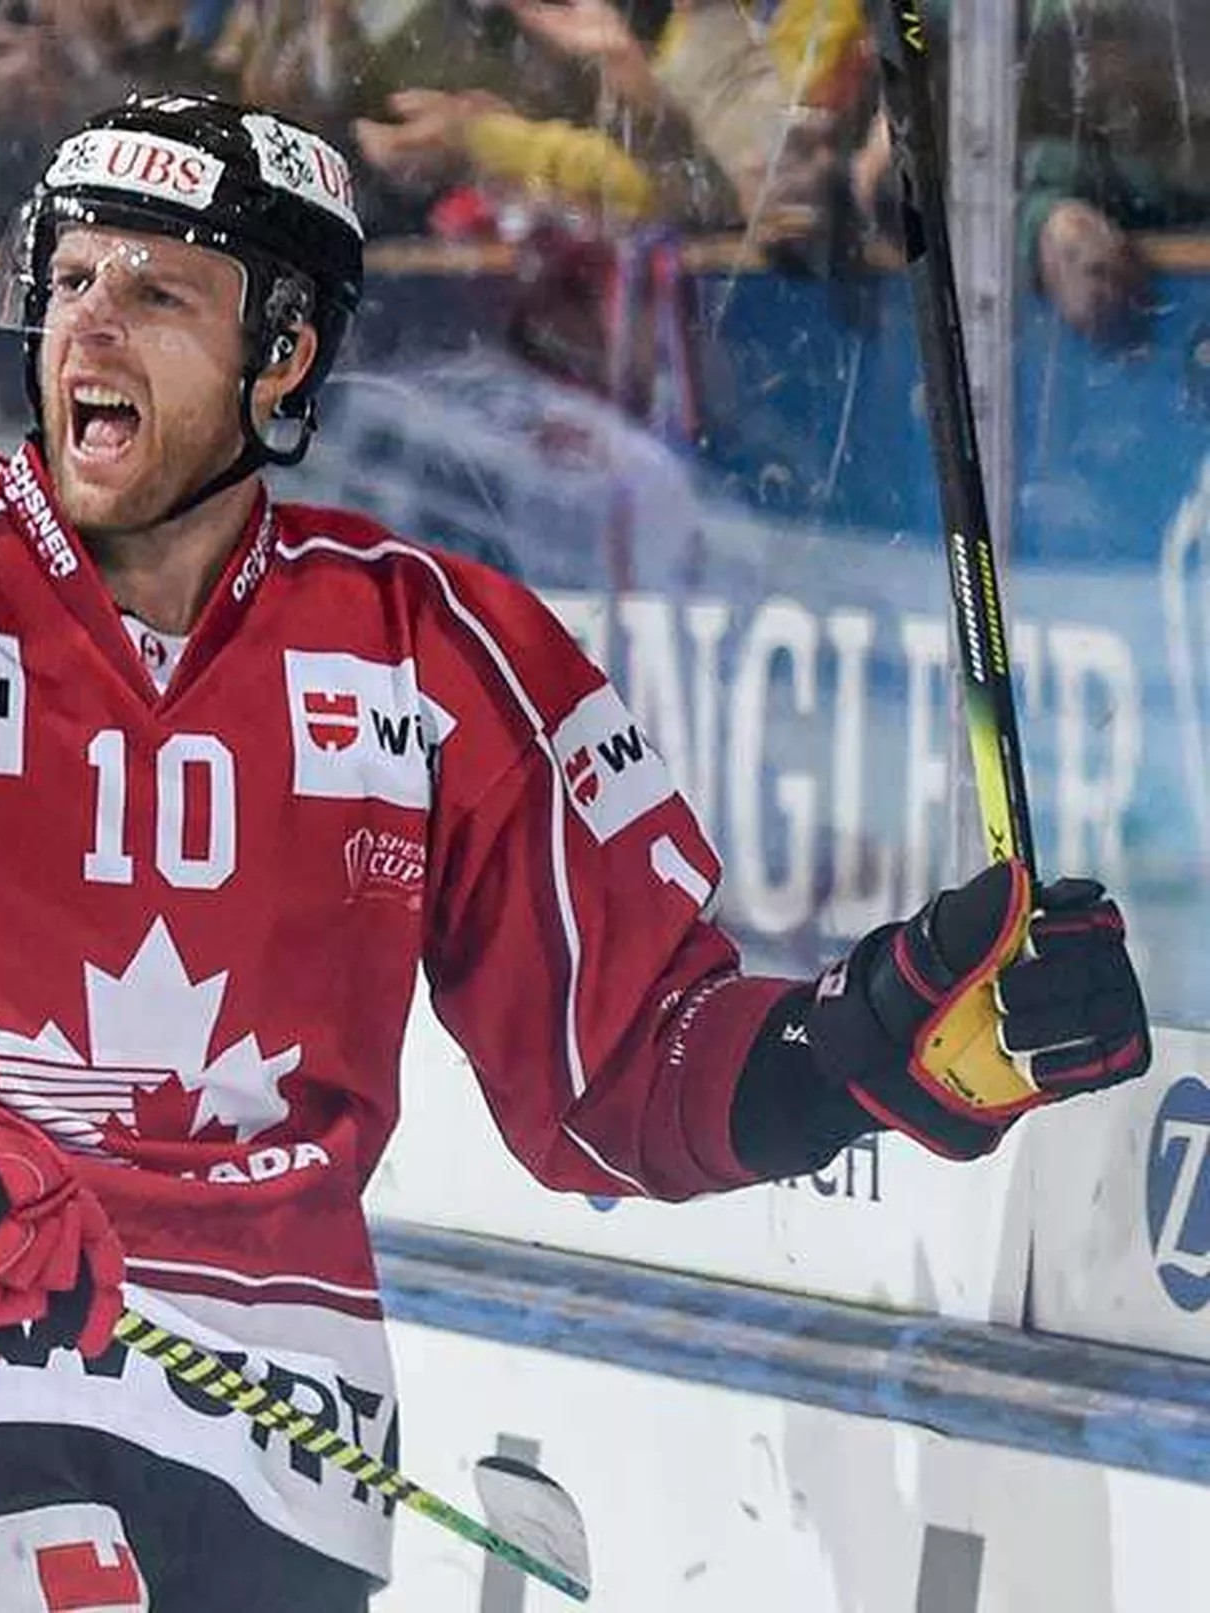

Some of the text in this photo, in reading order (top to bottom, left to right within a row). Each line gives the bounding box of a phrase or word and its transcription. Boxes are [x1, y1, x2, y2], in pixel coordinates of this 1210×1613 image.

[106, 139, 206, 195] UBS
[84, 729, 237, 888] 10
[369, 852, 425, 883] CUP
[180, 1142, 330, 1184] ADA
